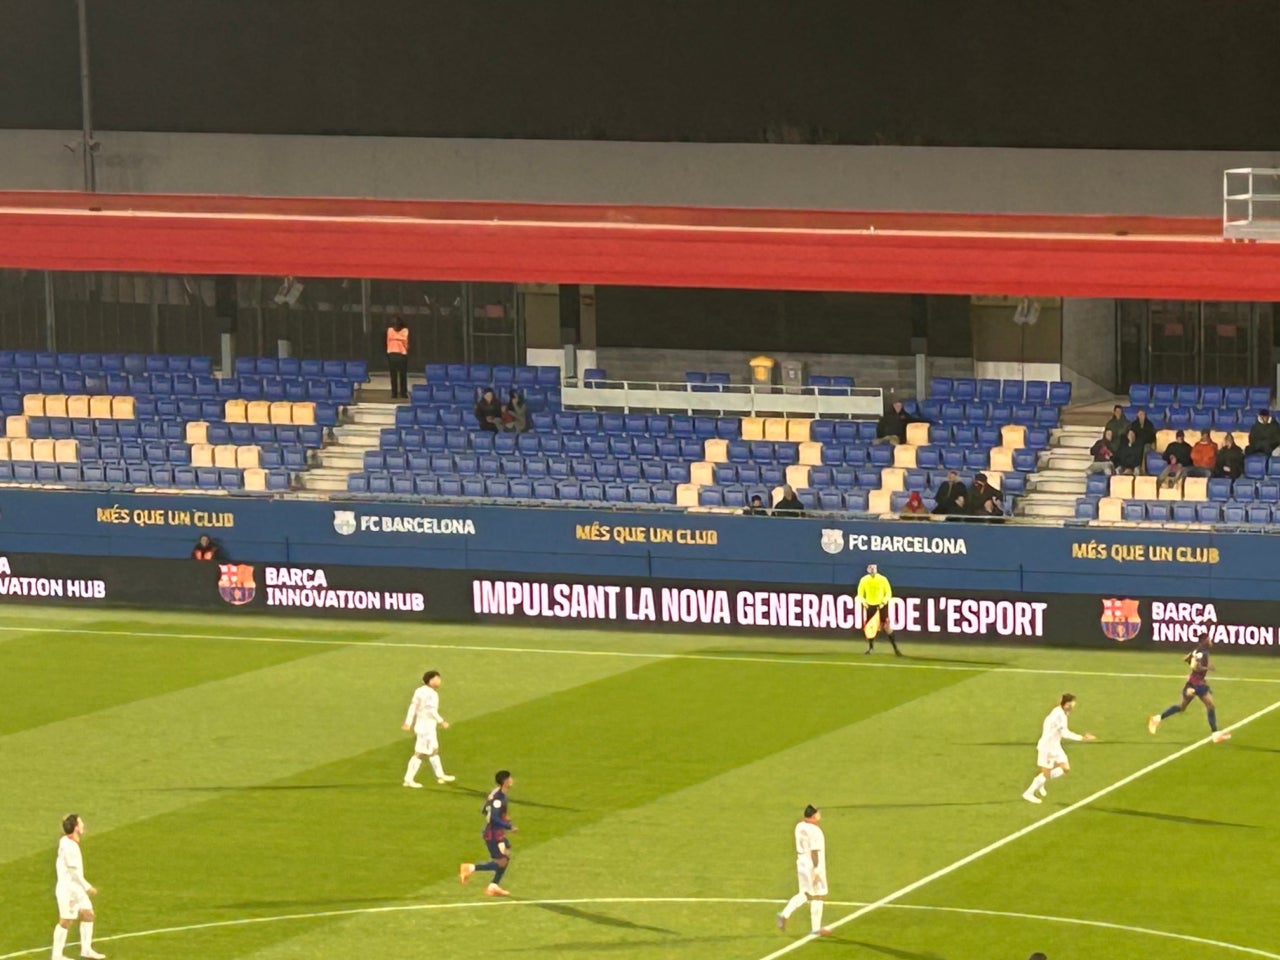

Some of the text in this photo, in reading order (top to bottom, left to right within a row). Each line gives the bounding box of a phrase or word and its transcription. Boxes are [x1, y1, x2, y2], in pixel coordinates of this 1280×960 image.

[134, 509, 165, 527] QUE
[168, 510, 191, 526] UN
[360, 516, 476, 535] FC BARCELONA
[613, 526, 647, 544] QUE
[650, 527, 673, 543] UN
[848, 534, 967, 555] FC BARCELONA
[1111, 544, 1145, 562] QUE
[1149, 545, 1173, 562] UN
[1176, 547, 1220, 564] CLUB
[265, 567, 328, 588] BARÇA
[66, 579, 106, 598] HUB
[266, 588, 425, 611] INNOVATION HUB
[472, 580, 1048, 637] IMPULSANT LA NOVA GENERACI DE L'ESPORT
[1151, 602, 1217, 624] BARÇA
